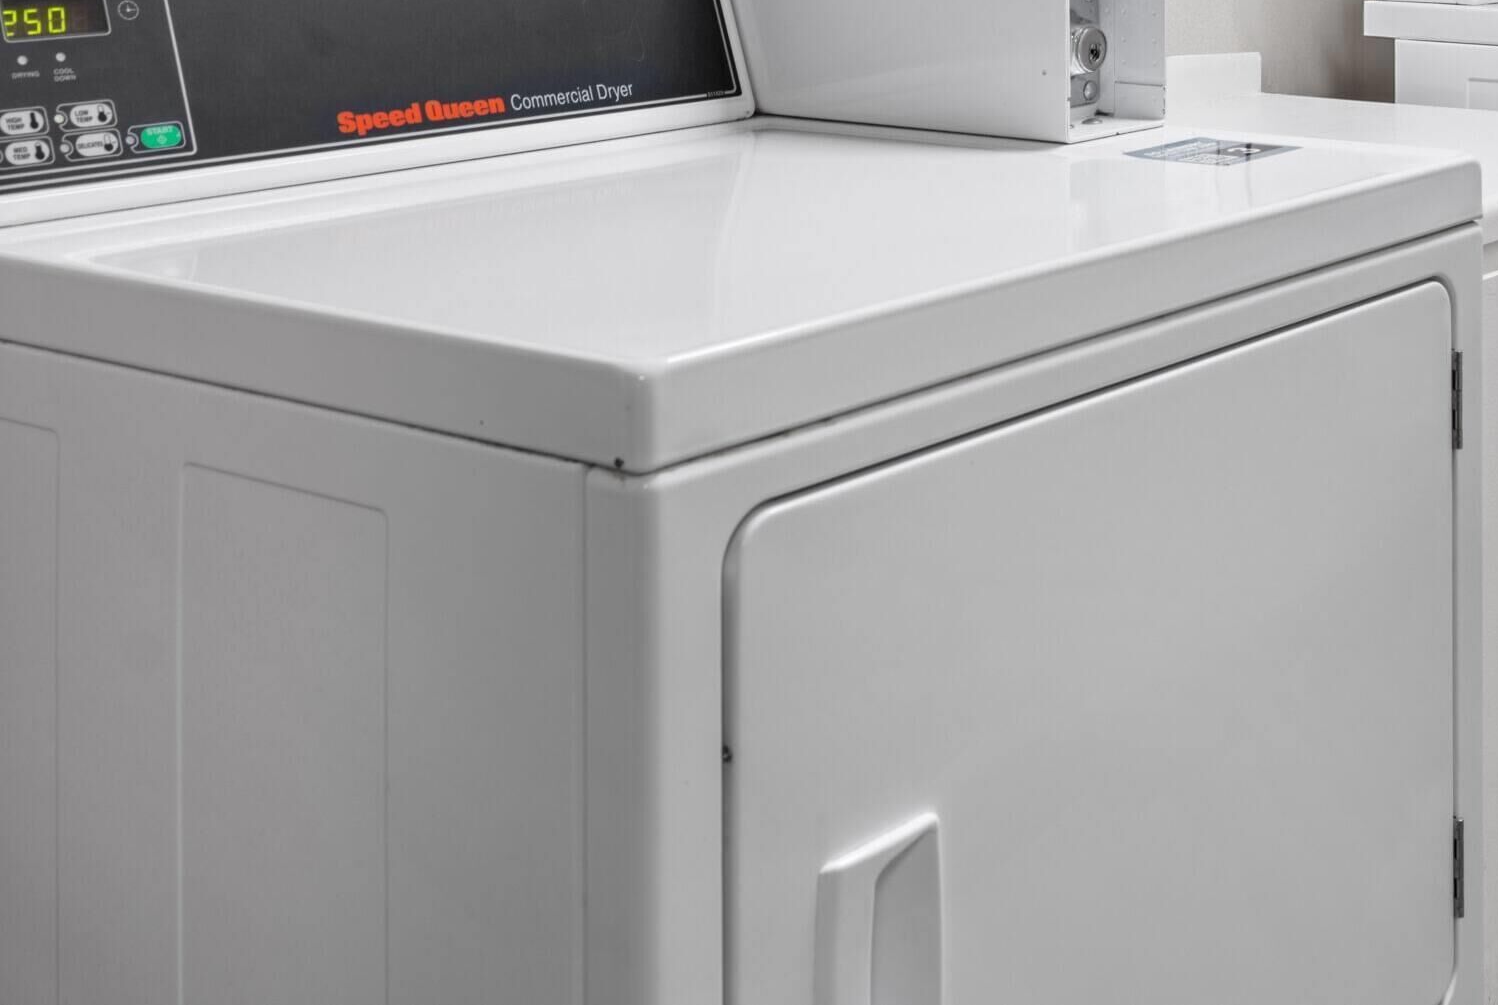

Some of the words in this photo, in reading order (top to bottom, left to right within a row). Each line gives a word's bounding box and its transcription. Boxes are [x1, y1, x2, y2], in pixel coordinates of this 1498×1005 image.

[336, 102, 421, 137] Speed
[425, 95, 506, 122] Queen
[510, 89, 594, 112] Commercial
[597, 81, 634, 101] Dryer
[146, 125, 173, 135] START
